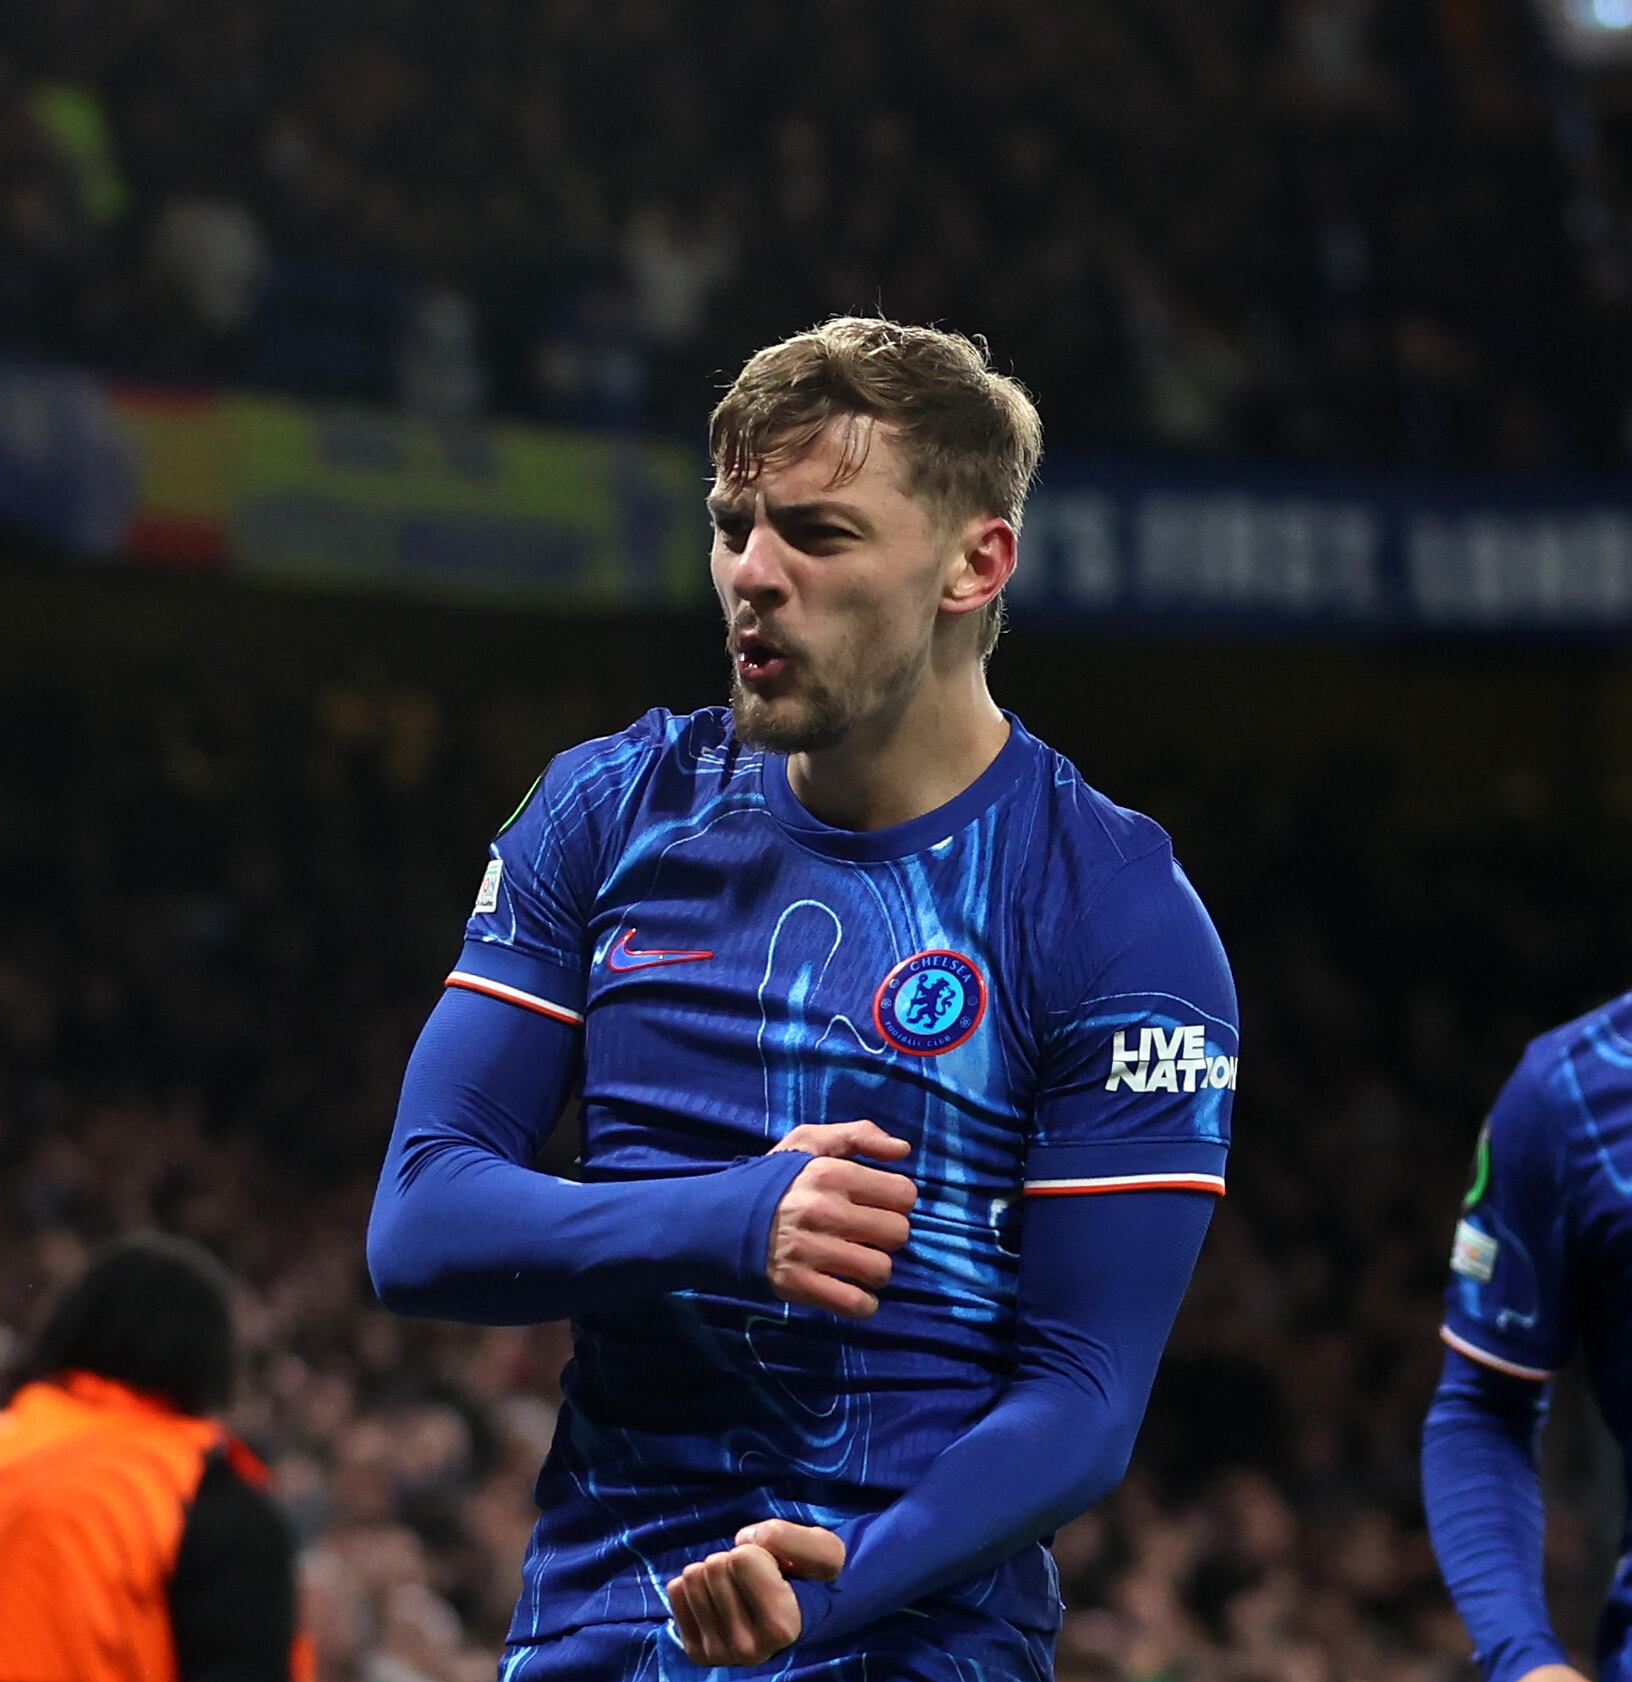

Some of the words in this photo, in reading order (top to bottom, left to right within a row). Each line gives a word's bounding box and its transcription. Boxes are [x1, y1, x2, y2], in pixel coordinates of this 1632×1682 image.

[909, 955, 973, 983] CHELSEA
[1112, 1025, 1205, 1062] LIVE
[1105, 1055, 1239, 1093] NATION
